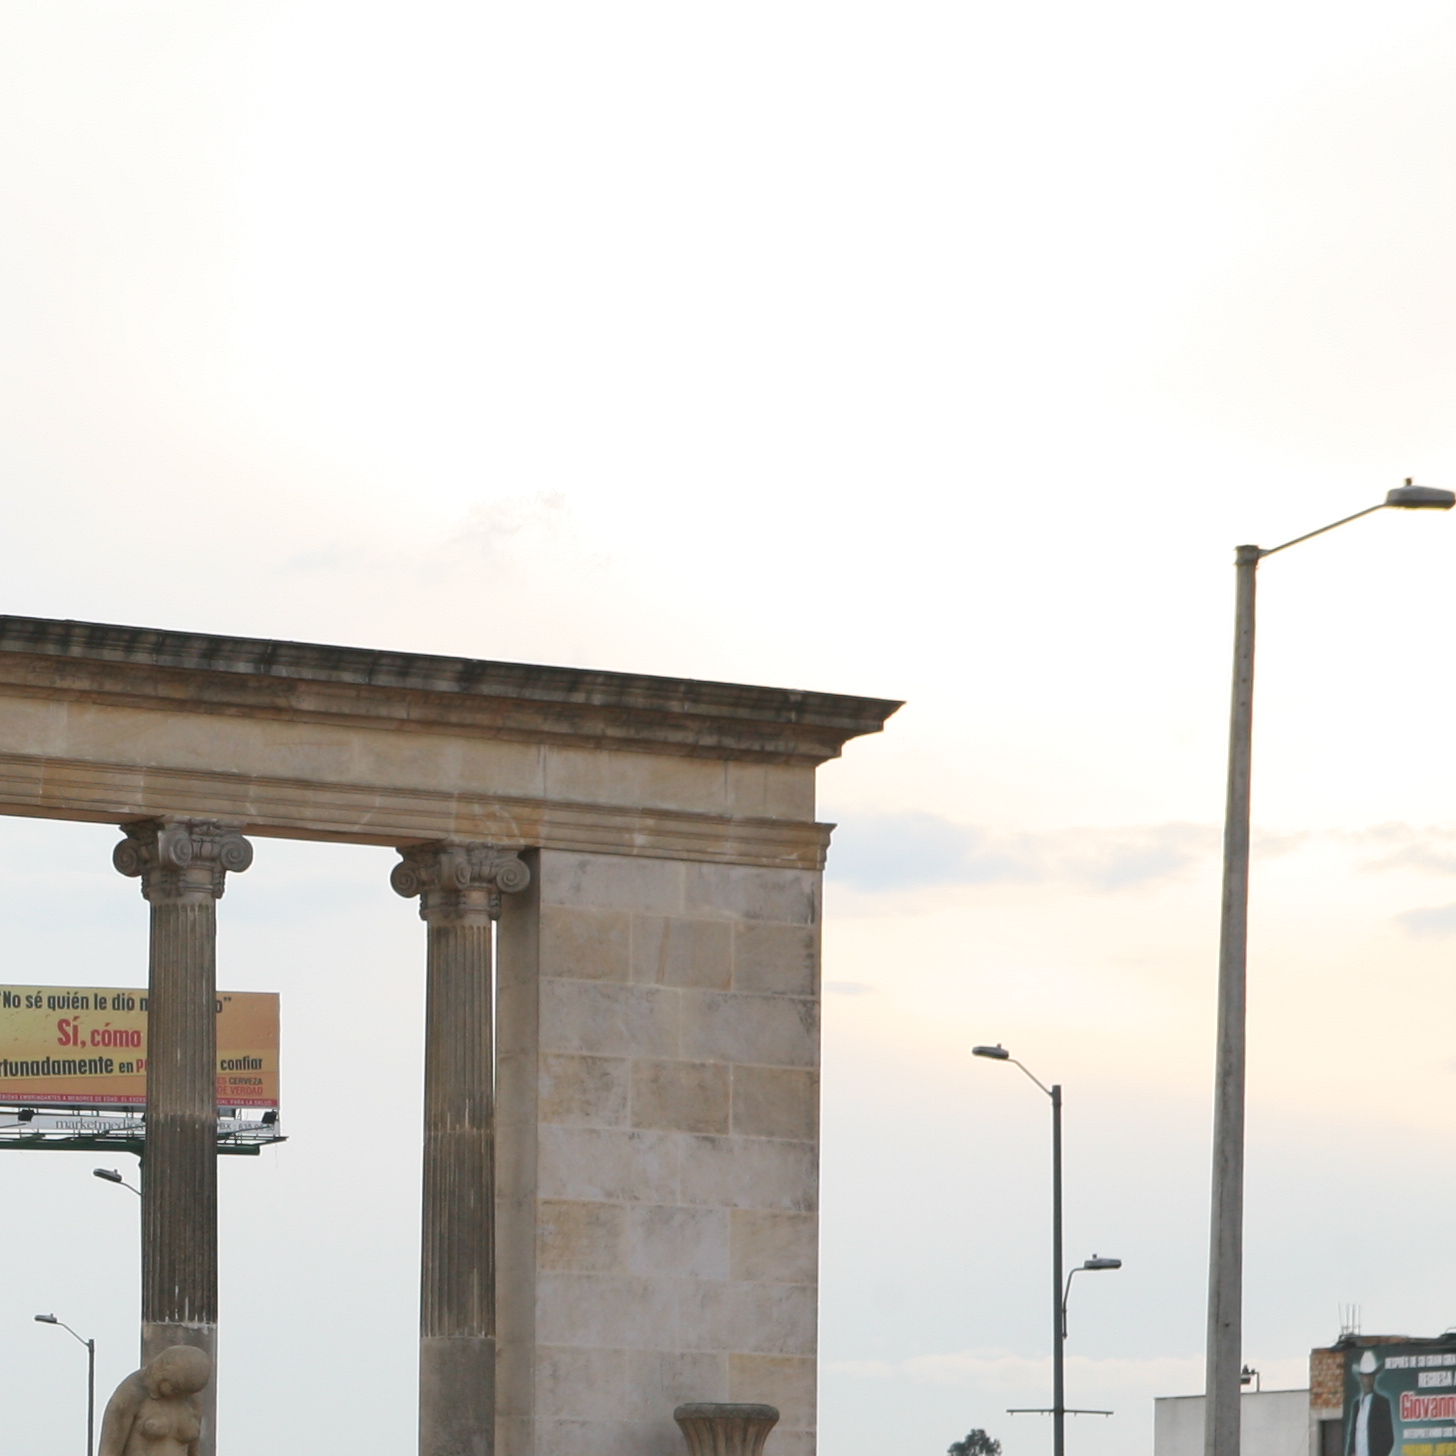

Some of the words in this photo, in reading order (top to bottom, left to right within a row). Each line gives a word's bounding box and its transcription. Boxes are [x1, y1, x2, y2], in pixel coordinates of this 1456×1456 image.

[25, 991, 43, 1009] sé
[47, 991, 90, 1011] quién
[94, 993, 107, 1010] le
[57, 1015, 86, 1048] Sí,
[90, 1022, 142, 1047] cómo
[119, 1061, 133, 1074] en
[220, 1055, 263, 1071] confiar
[229, 1077, 263, 1085] CERVEZA
[230, 1086, 263, 1095] VERDAD
[1400, 1391, 1456, 1421] Giovann
